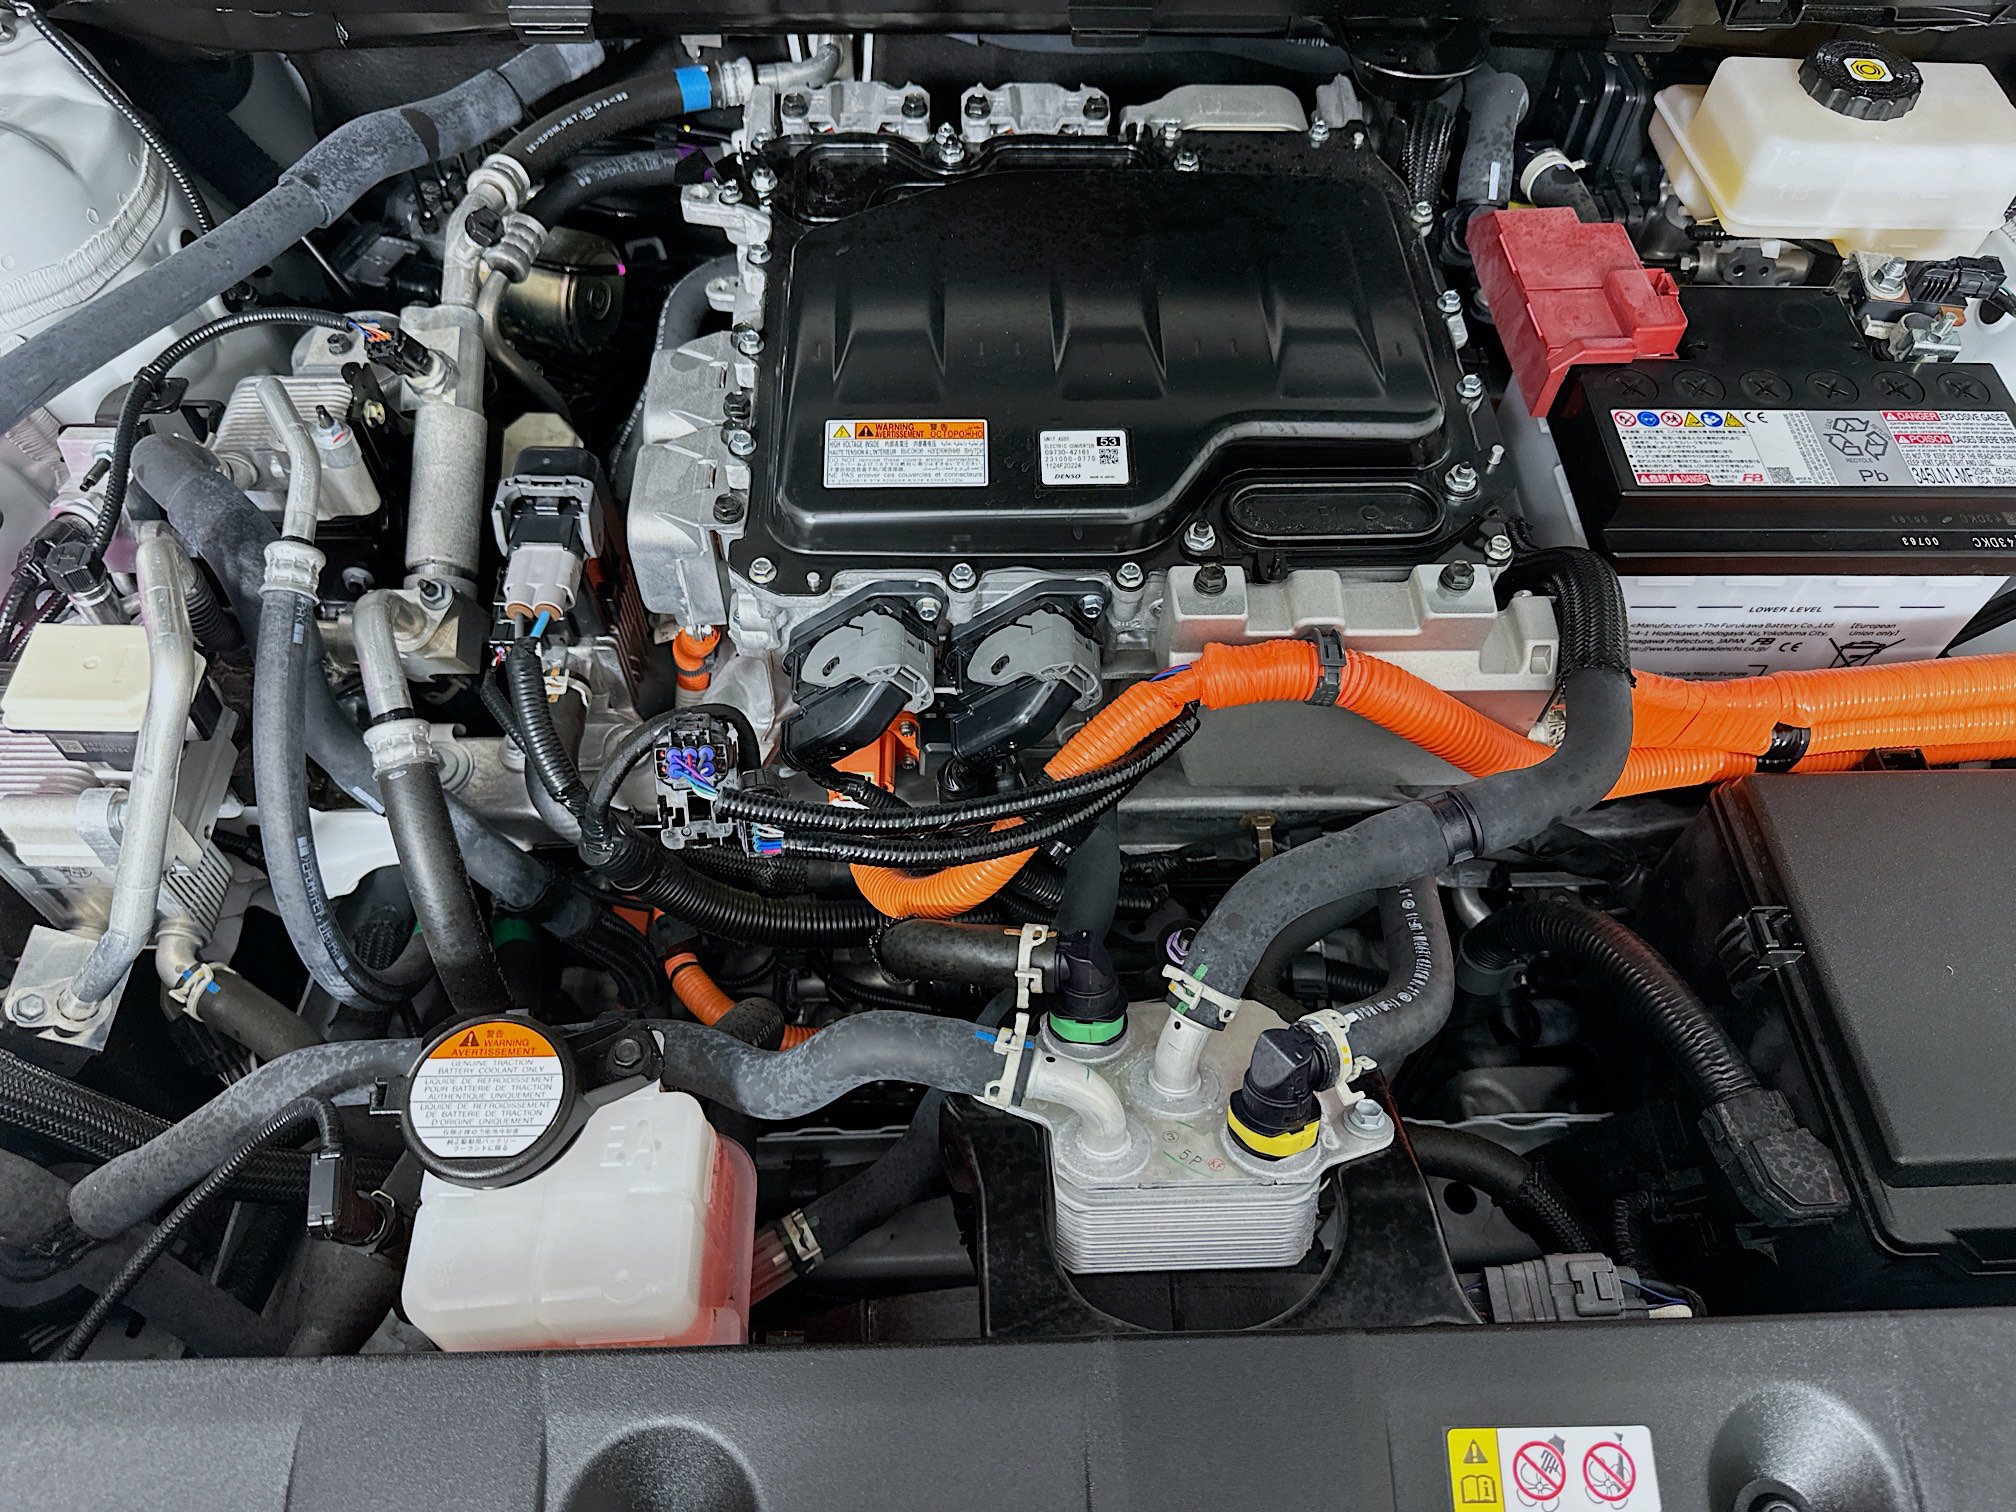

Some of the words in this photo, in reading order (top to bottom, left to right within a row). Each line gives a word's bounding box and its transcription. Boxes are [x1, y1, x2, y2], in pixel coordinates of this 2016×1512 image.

[1940, 413, 1981, 421] EXPLOSIVE
[1980, 413, 2008, 421] GASES
[875, 423, 915, 431] WARNING
[930, 423, 949, 431] 警告
[930, 430, 984, 439] ОСТОРОЖНО
[1100, 437, 1117, 446] 53
[1909, 435, 1951, 443] POISON
[1681, 474, 1709, 483] DANGER
[1859, 469, 1889, 482] Pb
[1911, 467, 1974, 484] 345LN1-MF
[1779, 642, 1803, 652] CE
[484, 1039, 530, 1047] WARNING
[451, 1047, 537, 1056] AVERTISSEMENT
[477, 1076, 554, 1084] REFROIDISSEMENT
[473, 1101, 550, 1109] REFROIDISSEMENT
[478, 1117, 534, 1125] UNIQUEMENT
